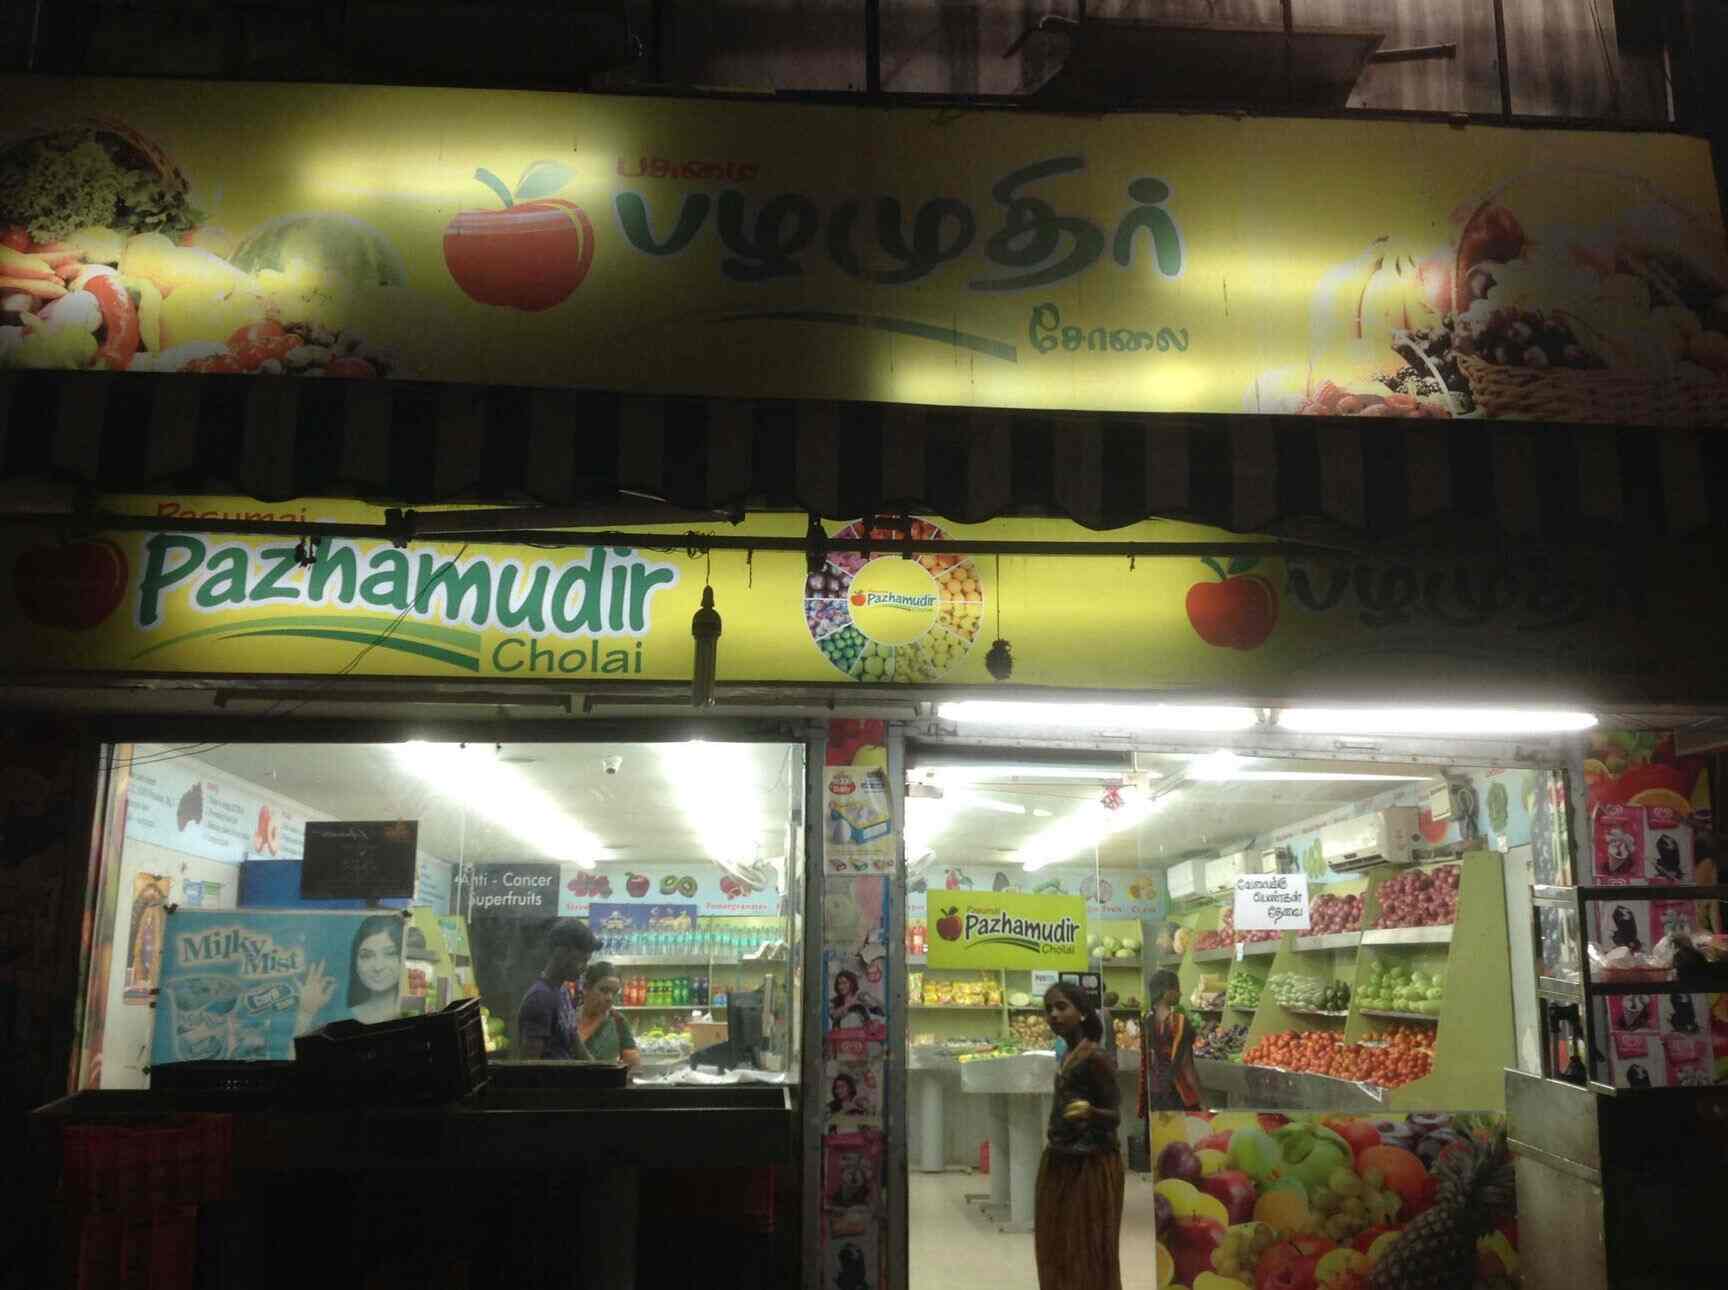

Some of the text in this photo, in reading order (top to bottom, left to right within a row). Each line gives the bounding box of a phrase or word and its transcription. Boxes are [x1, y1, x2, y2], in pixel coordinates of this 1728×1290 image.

[614, 155, 1183, 292] பழமுதிர்
[1027, 302, 1190, 355] சோலை
[139, 532, 674, 632] Pazhamudir
[491, 638, 644, 673] Cholai
[502, 872, 553, 887] Cancer
[182, 928, 267, 961] Milky
[965, 911, 1080, 944] Pazhamudir
[241, 950, 298, 975] Mist
